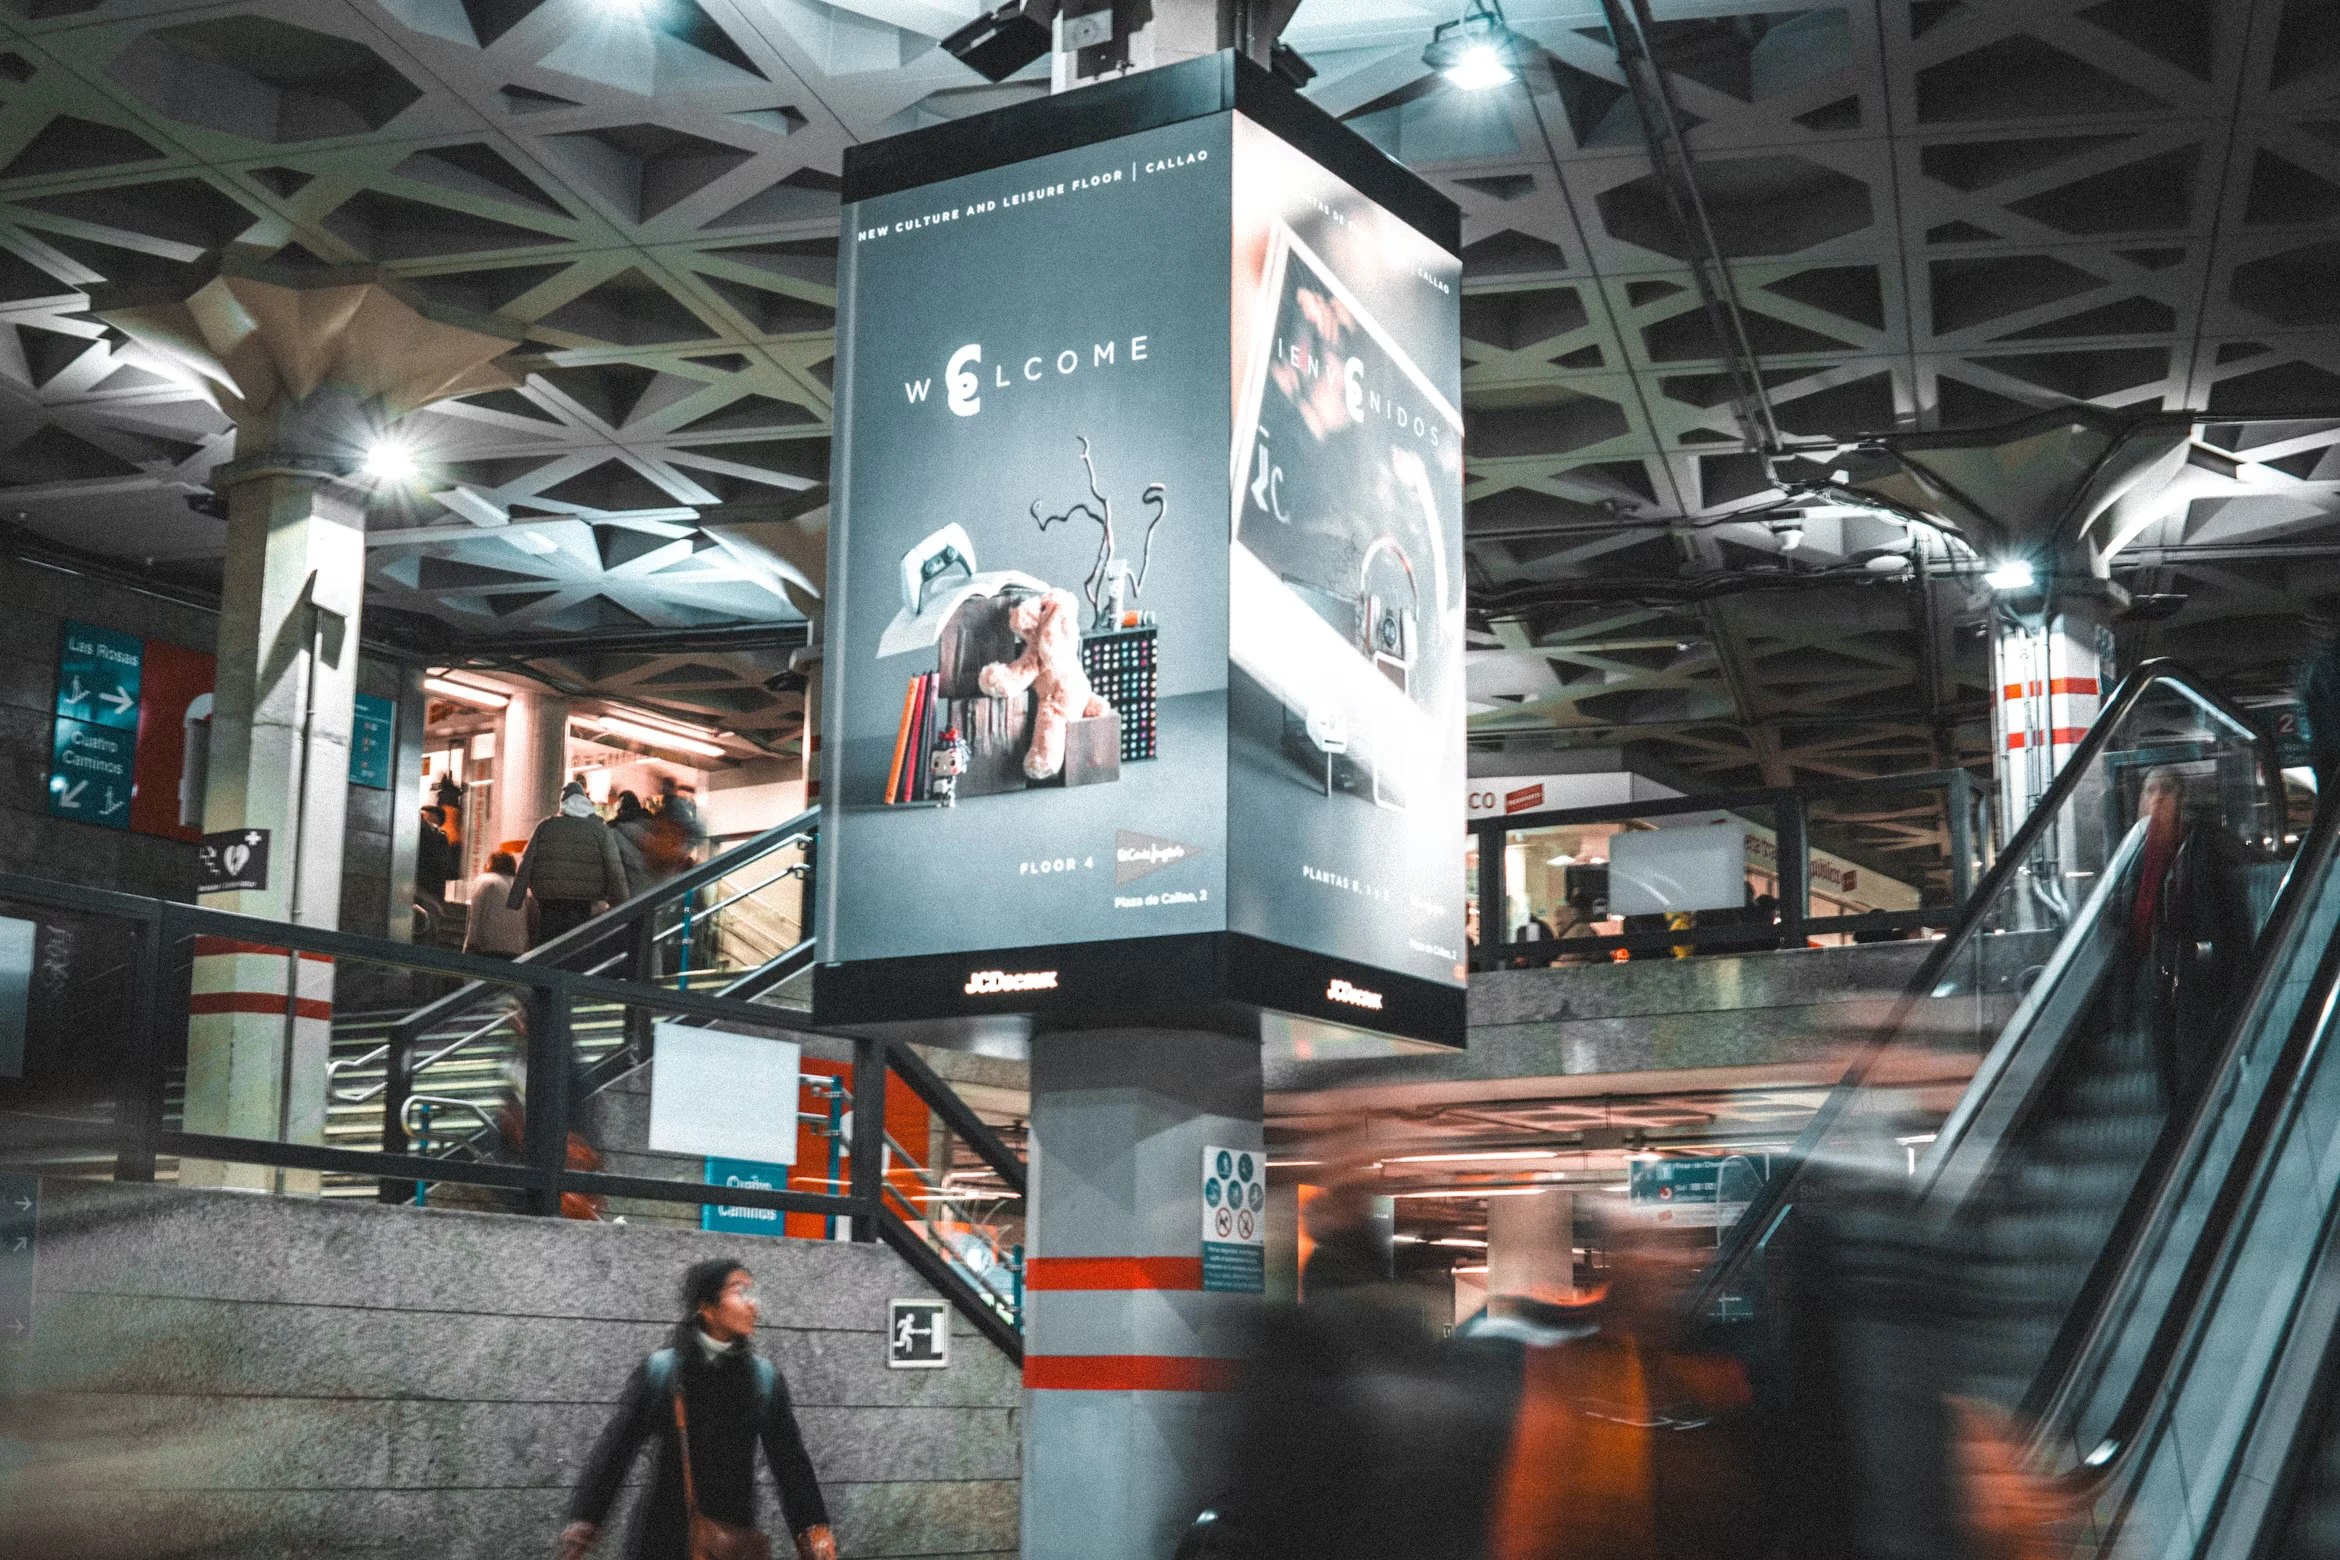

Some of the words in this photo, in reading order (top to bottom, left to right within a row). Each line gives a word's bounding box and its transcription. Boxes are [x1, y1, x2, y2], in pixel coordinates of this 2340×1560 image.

[858, 225, 889, 242] NEW
[895, 208, 960, 233] CULTURE
[966, 200, 996, 217] AND
[1003, 184, 1065, 208] LEISURE
[1072, 170, 1123, 192] FLOOR
[1145, 150, 1208, 174] CALLAO
[1418, 267, 1450, 294] CALLAO
[68, 636, 94, 655] Las
[71, 730, 118, 753] Cuatro
[63, 750, 123, 775] Caminos
[1020, 858, 1076, 875] FLOOR
[1084, 856, 1094, 869] 4
[1302, 864, 1349, 890] PLANTAS
[1145, 894, 1159, 905] de
[1199, 889, 1208, 901] 2
